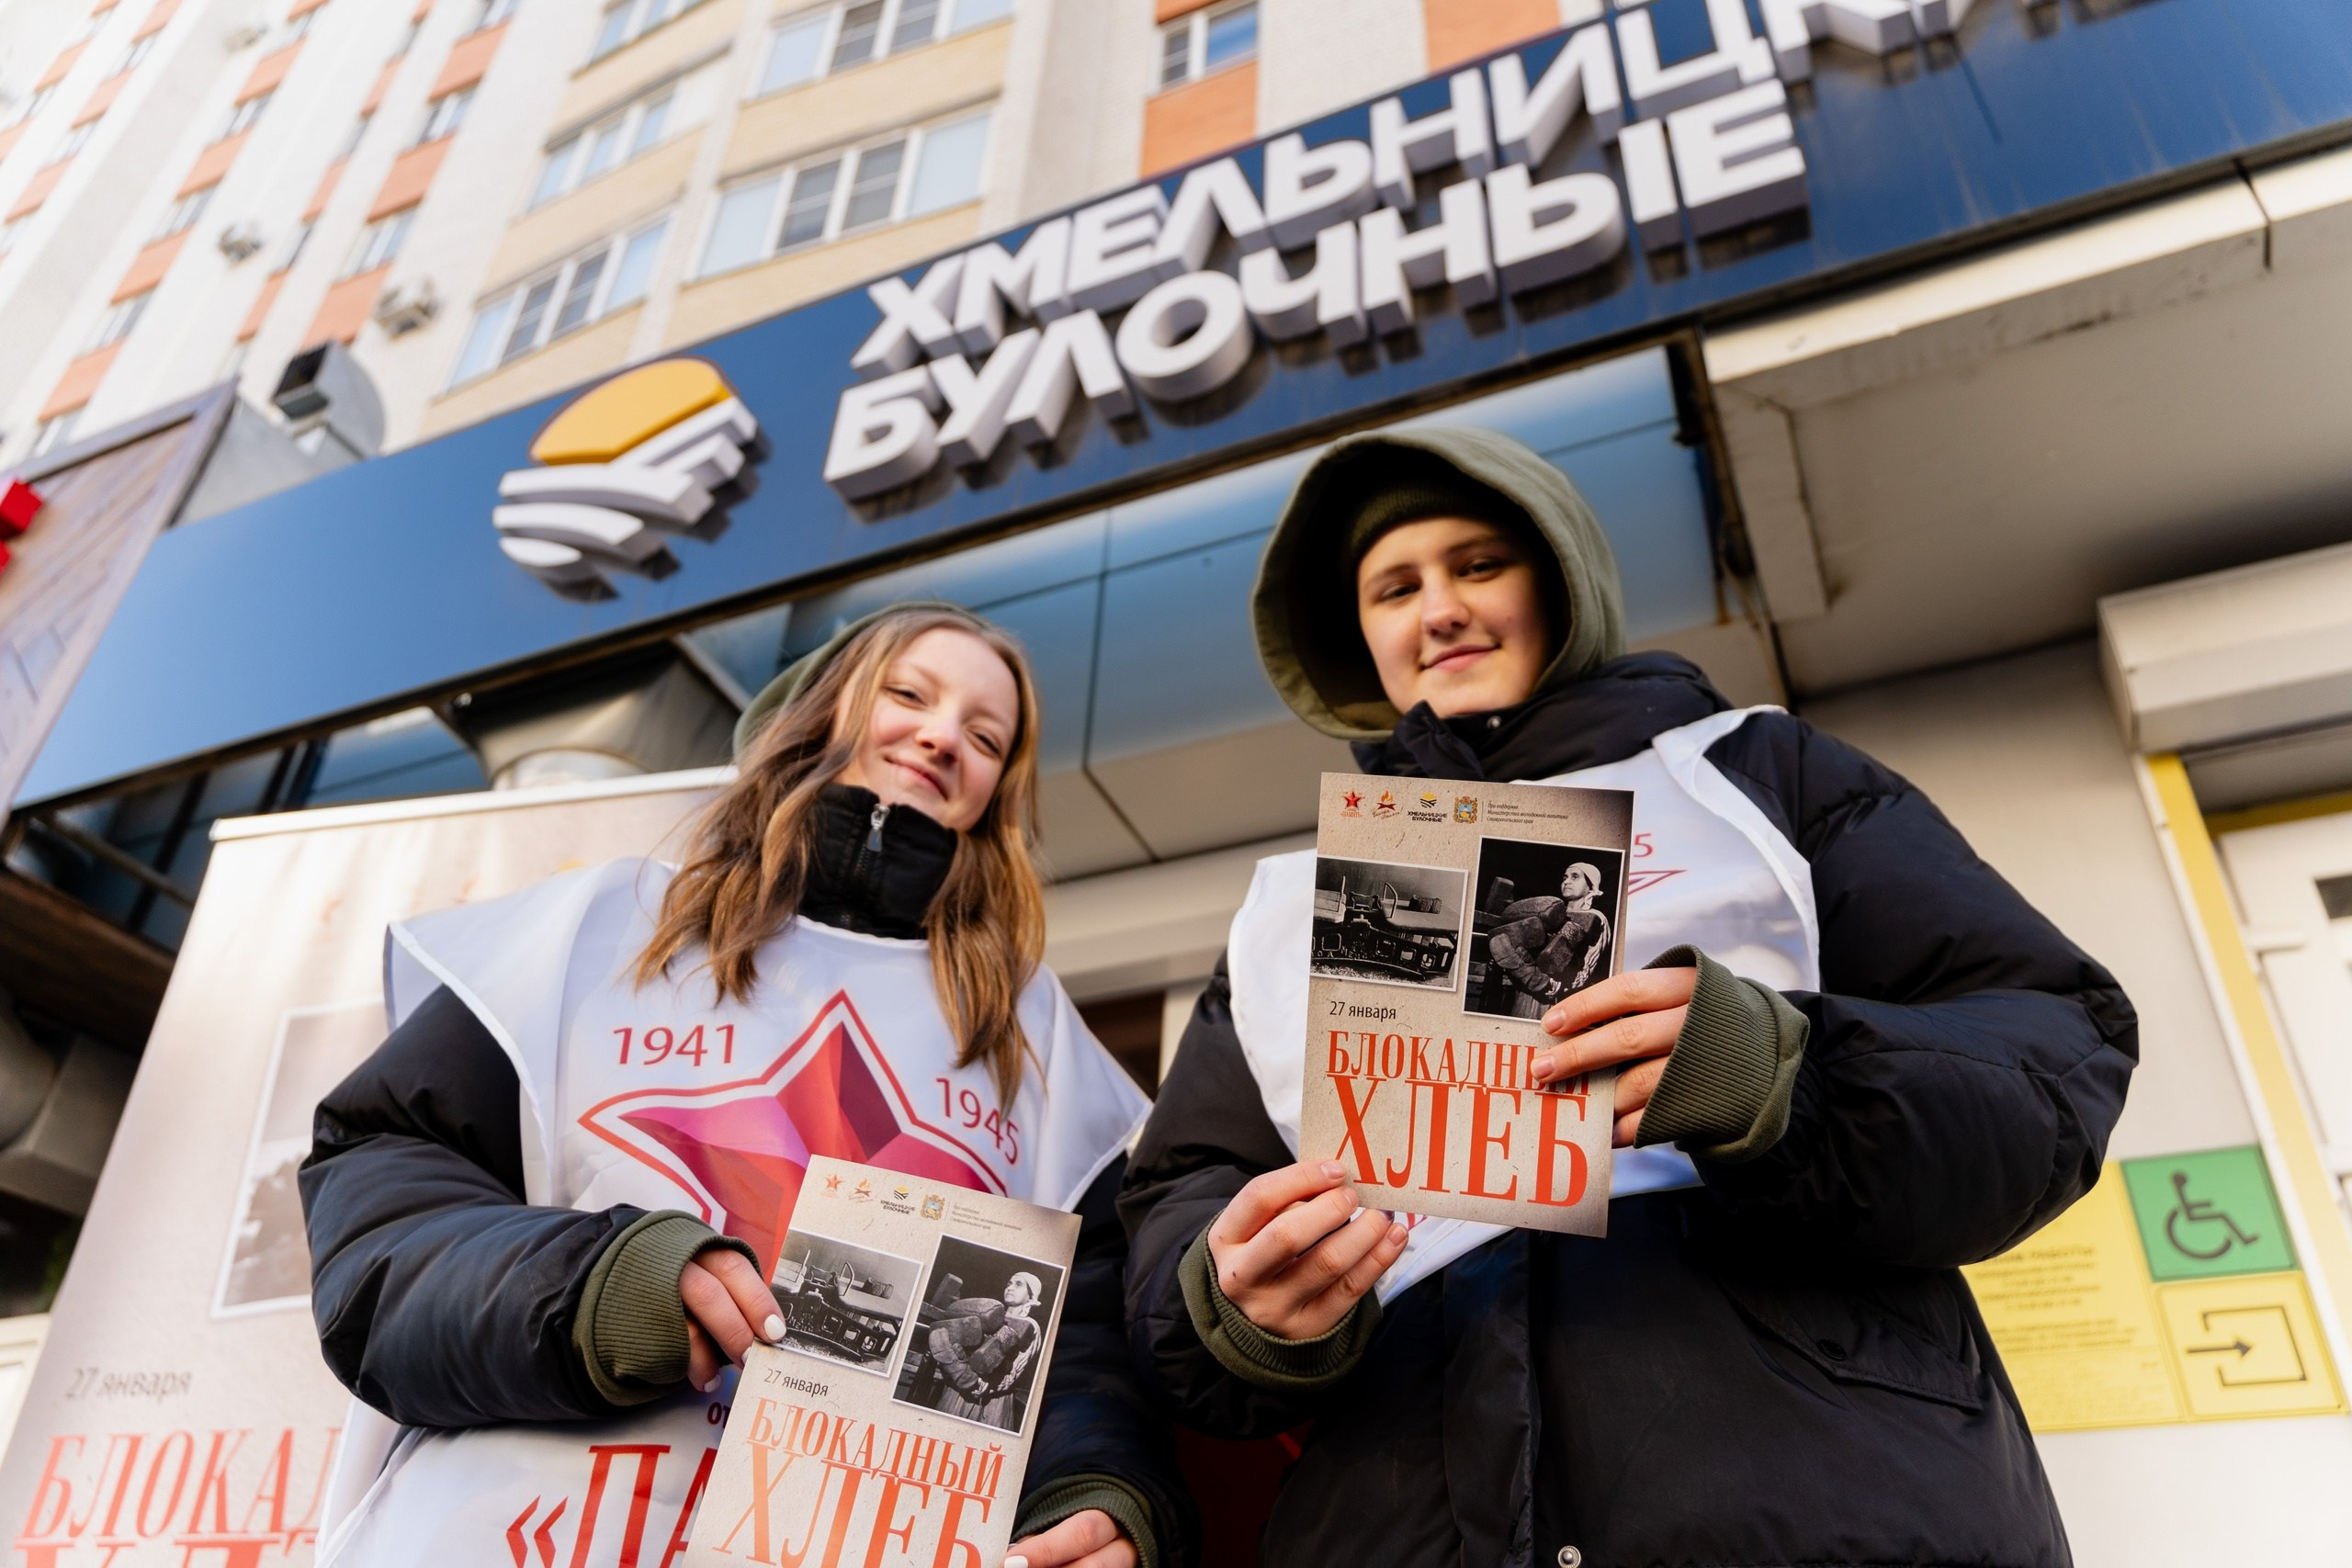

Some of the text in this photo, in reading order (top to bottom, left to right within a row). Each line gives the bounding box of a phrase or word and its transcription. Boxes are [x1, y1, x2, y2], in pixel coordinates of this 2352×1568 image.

[824, 78, 1806, 483] БУЛОЧНЫЕ
[614, 1024, 734, 1066] 1941
[1329, 1001, 1396, 1022] 27 января
[935, 1077, 1019, 1165] 1945
[1326, 1073, 1589, 1207] ХЛЕБ
[65, 1367, 192, 1404] 27 января
[763, 1368, 829, 1398] 27 января
[746, 1396, 1007, 1499] БЛОКАДНЫЙ
[712, 1439, 992, 1568] ХЛЕБ
